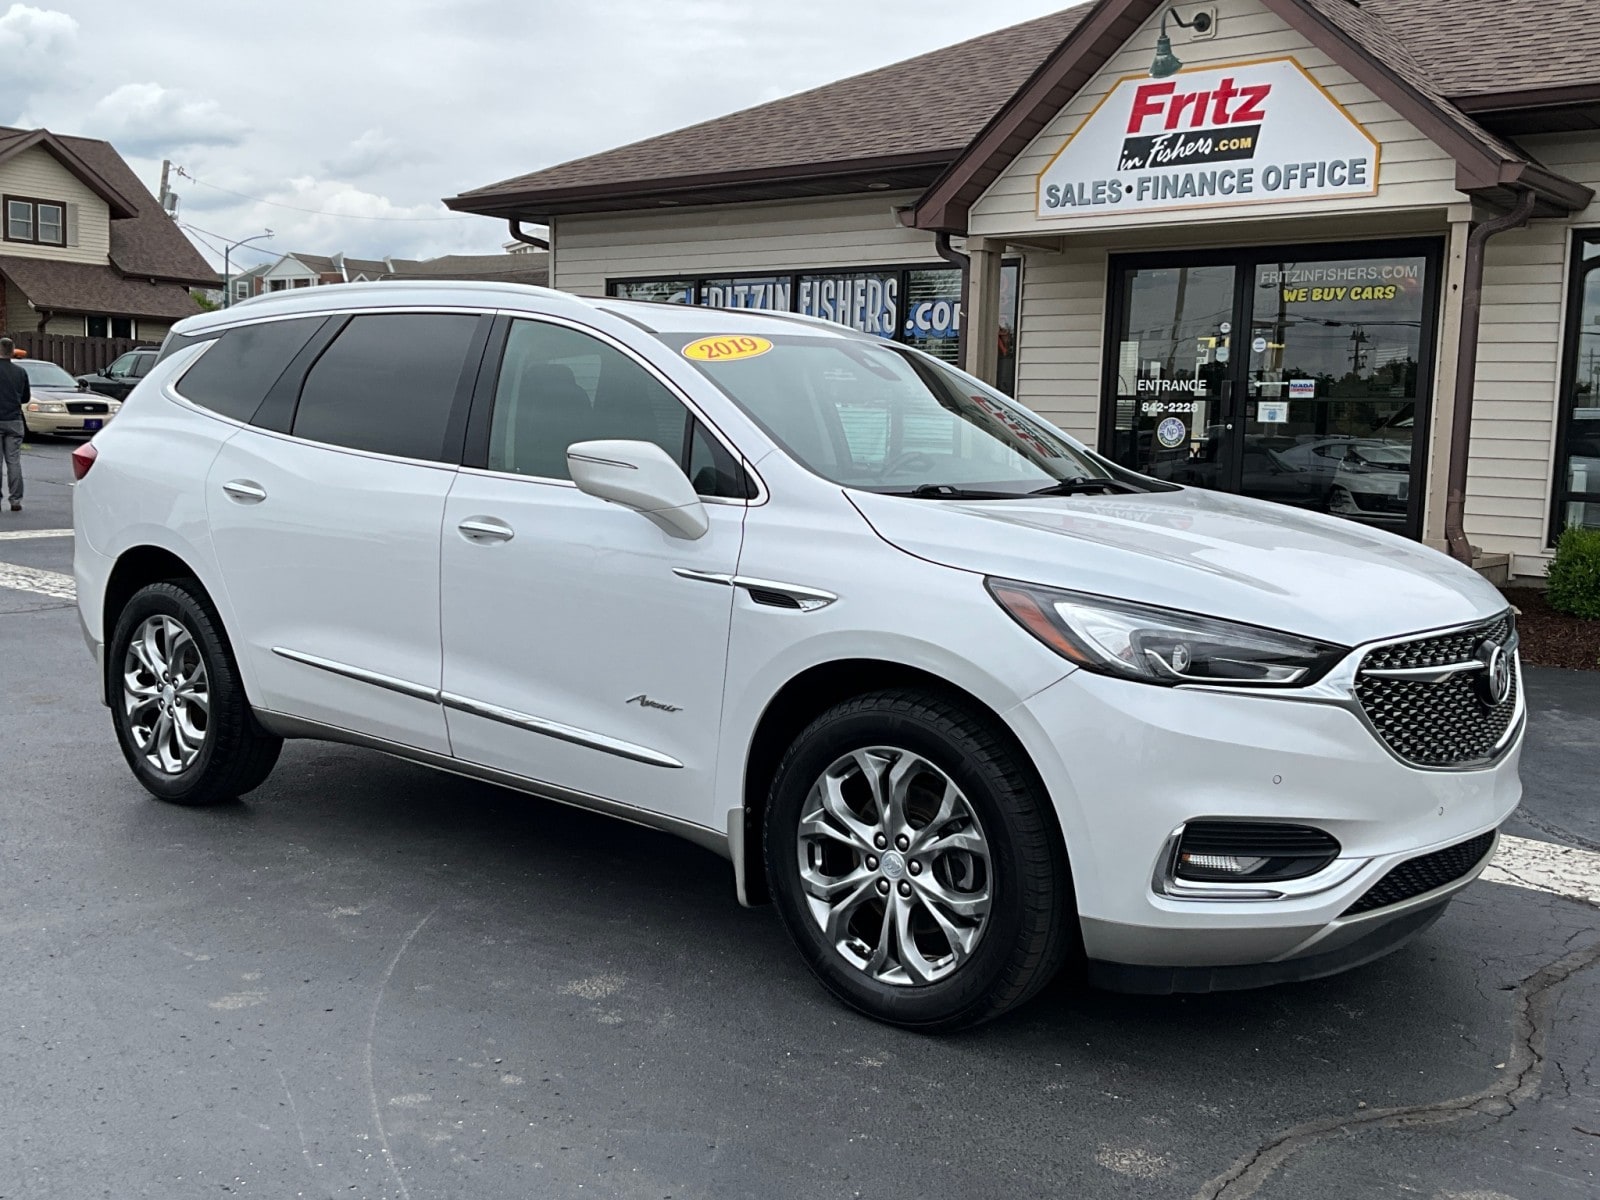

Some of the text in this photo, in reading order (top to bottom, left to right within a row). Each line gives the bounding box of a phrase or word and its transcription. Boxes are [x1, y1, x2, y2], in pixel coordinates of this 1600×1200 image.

[1126, 78, 1272, 134] Fritz
[1118, 149, 1145, 171] in
[1045, 158, 1367, 208] SALES FINANCE OFFICE
[1260, 265, 1418, 284] FRITZINFISHERS.COM
[1283, 285, 1396, 302] WE BUY CARS
[800, 278, 898, 333] FISHERS
[699, 337, 759, 359] 2019
[1137, 379, 1207, 392] ENTRANCE
[1141, 402, 1199, 413] 842-2228
